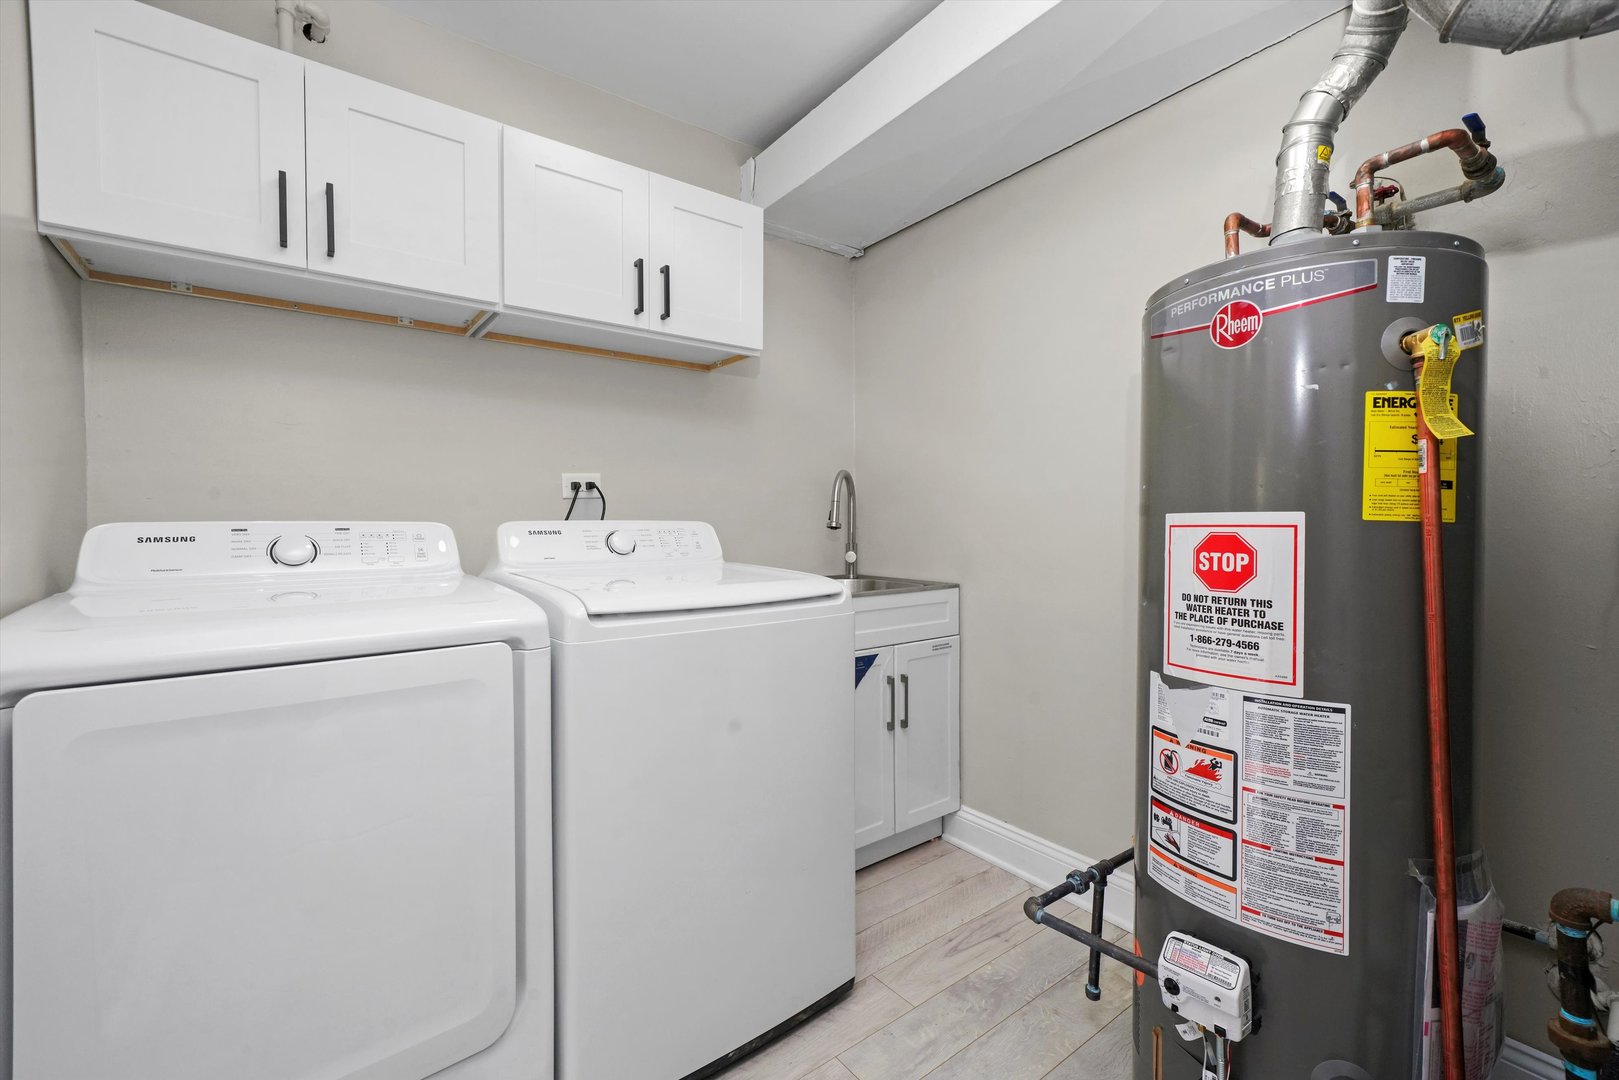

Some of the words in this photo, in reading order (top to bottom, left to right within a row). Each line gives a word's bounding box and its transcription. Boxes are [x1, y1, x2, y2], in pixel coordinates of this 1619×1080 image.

[1171, 278, 1276, 318] PERFORMANCE
[1216, 303, 1258, 342] Rheem
[1199, 552, 1250, 572] STOP
[1182, 592, 1192, 602] DO
[1194, 594, 1208, 604] NOT
[1212, 596, 1246, 606] RETURN
[1250, 599, 1272, 608] THIS
[1186, 603, 1212, 614] WATER
[1215, 606, 1250, 618] HEATER
[1253, 610, 1266, 619] TO
[1175, 612, 1187, 620] THE
[1190, 613, 1214, 624] PLACE
[1217, 616, 1228, 626] OF
[1231, 618, 1284, 630] PURCHASE
[1190, 634, 1260, 650] 1-866-279-4566
[1175, 813, 1200, 827] DANGER
